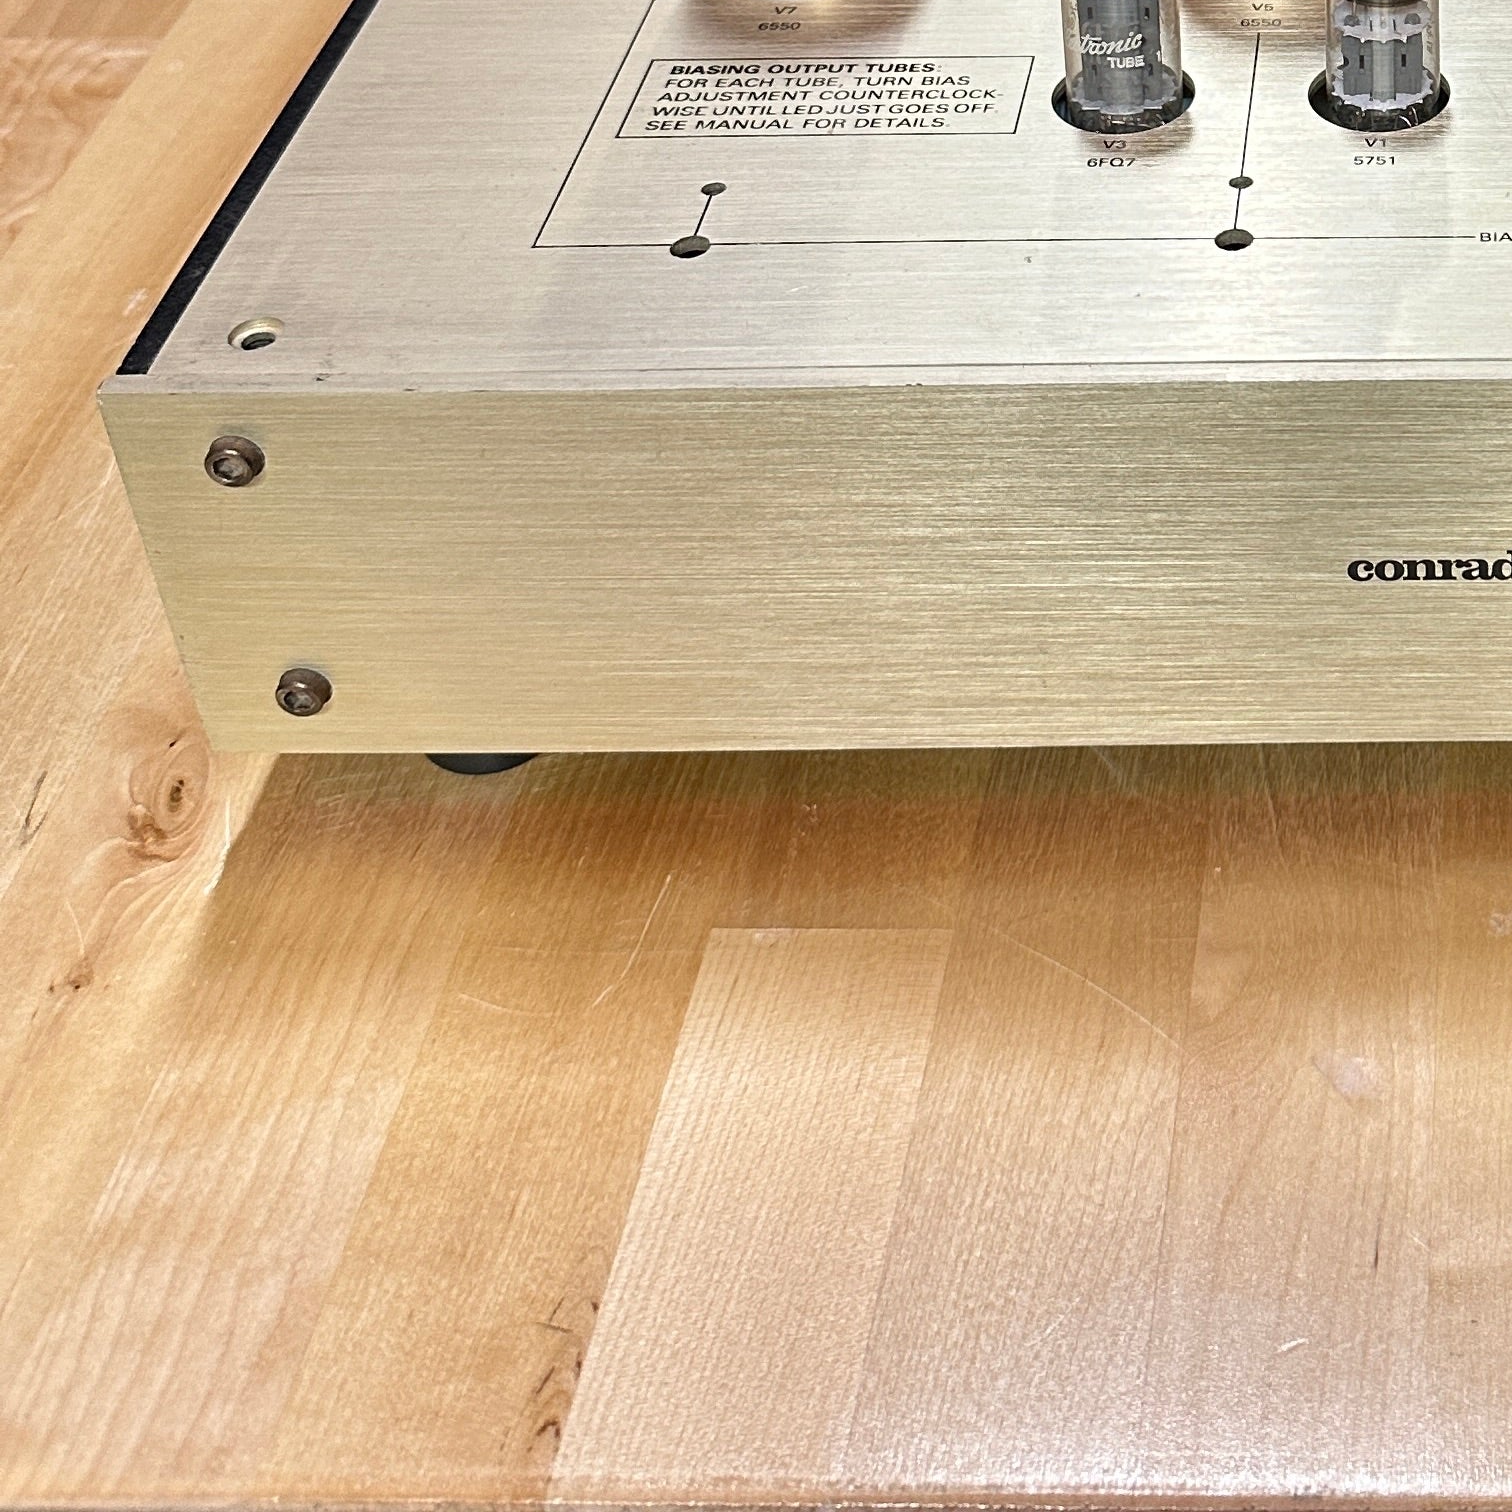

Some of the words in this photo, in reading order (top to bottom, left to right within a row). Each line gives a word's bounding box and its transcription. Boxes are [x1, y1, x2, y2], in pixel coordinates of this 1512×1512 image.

[775, 6, 797, 14] V7
[758, 21, 801, 30] 6550
[1107, 54, 1146, 69] TUBE
[669, 64, 762, 75] BIASING
[767, 63, 859, 74] OUTPUT
[865, 63, 942, 73] TUBES:
[664, 78, 709, 88] FOR
[714, 78, 775, 88] EACH
[783, 77, 844, 88] TUBE,
[853, 76, 914, 87] TURN
[920, 76, 971, 86] BIAS
[656, 91, 813, 102] ADJUSTMENT
[818, 89, 1005, 100] COUNTERCLOCK-
[652, 106, 709, 117] WISE
[712, 105, 778, 116] UNTIL
[781, 105, 824, 115] LED
[825, 104, 887, 115] JUST
[888, 103, 949, 114] GOES
[954, 103, 1000, 114] OFF.
[645, 120, 688, 131] SEE
[694, 119, 794, 130] MANUAL
[802, 118, 848, 130] FOR
[1103, 140, 1127, 149] V3
[1364, 138, 1387, 148] V1
[1087, 157, 1136, 168] 6FQ7
[1353, 156, 1396, 166] 5751
